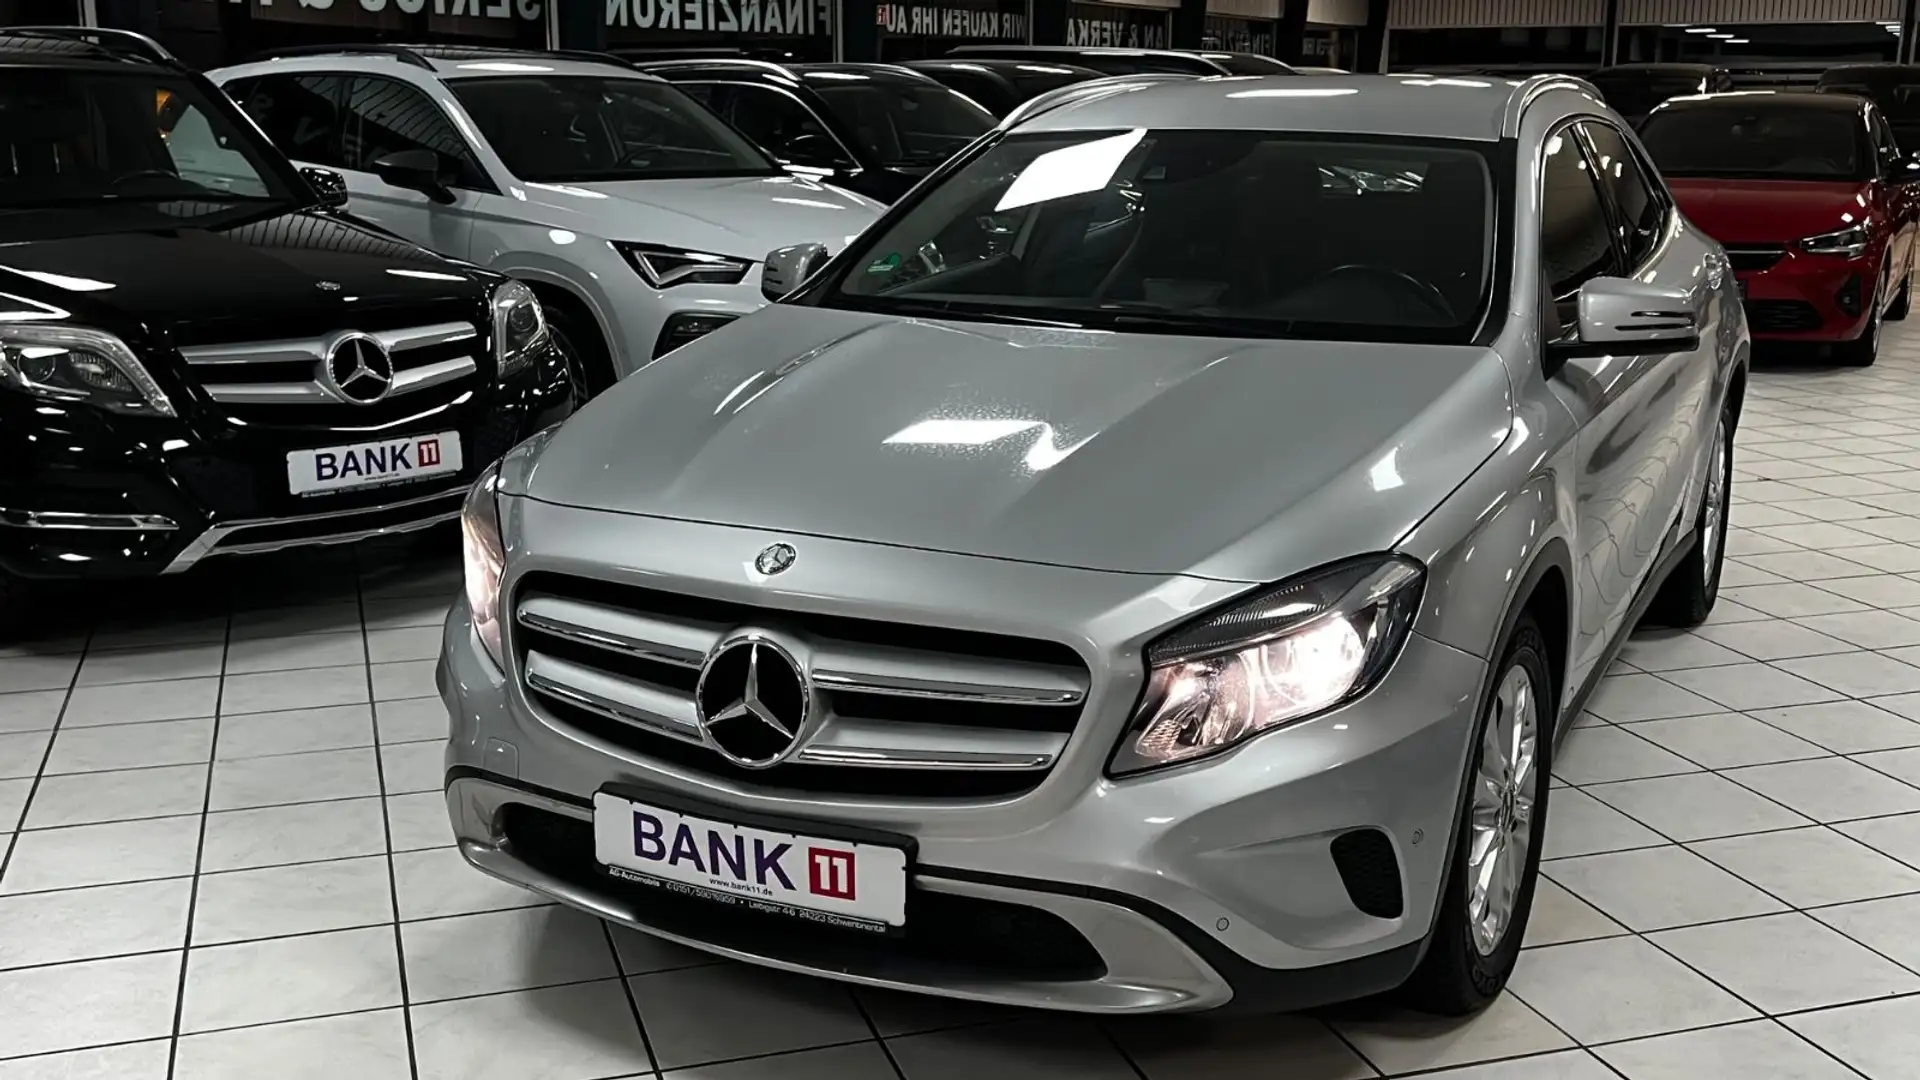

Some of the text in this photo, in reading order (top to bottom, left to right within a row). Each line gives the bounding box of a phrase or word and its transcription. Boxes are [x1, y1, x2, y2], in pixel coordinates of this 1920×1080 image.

[315, 441, 439, 481] BANK 11
[633, 811, 850, 896] BANK 11
[708, 877, 774, 897] www.bank11.de
